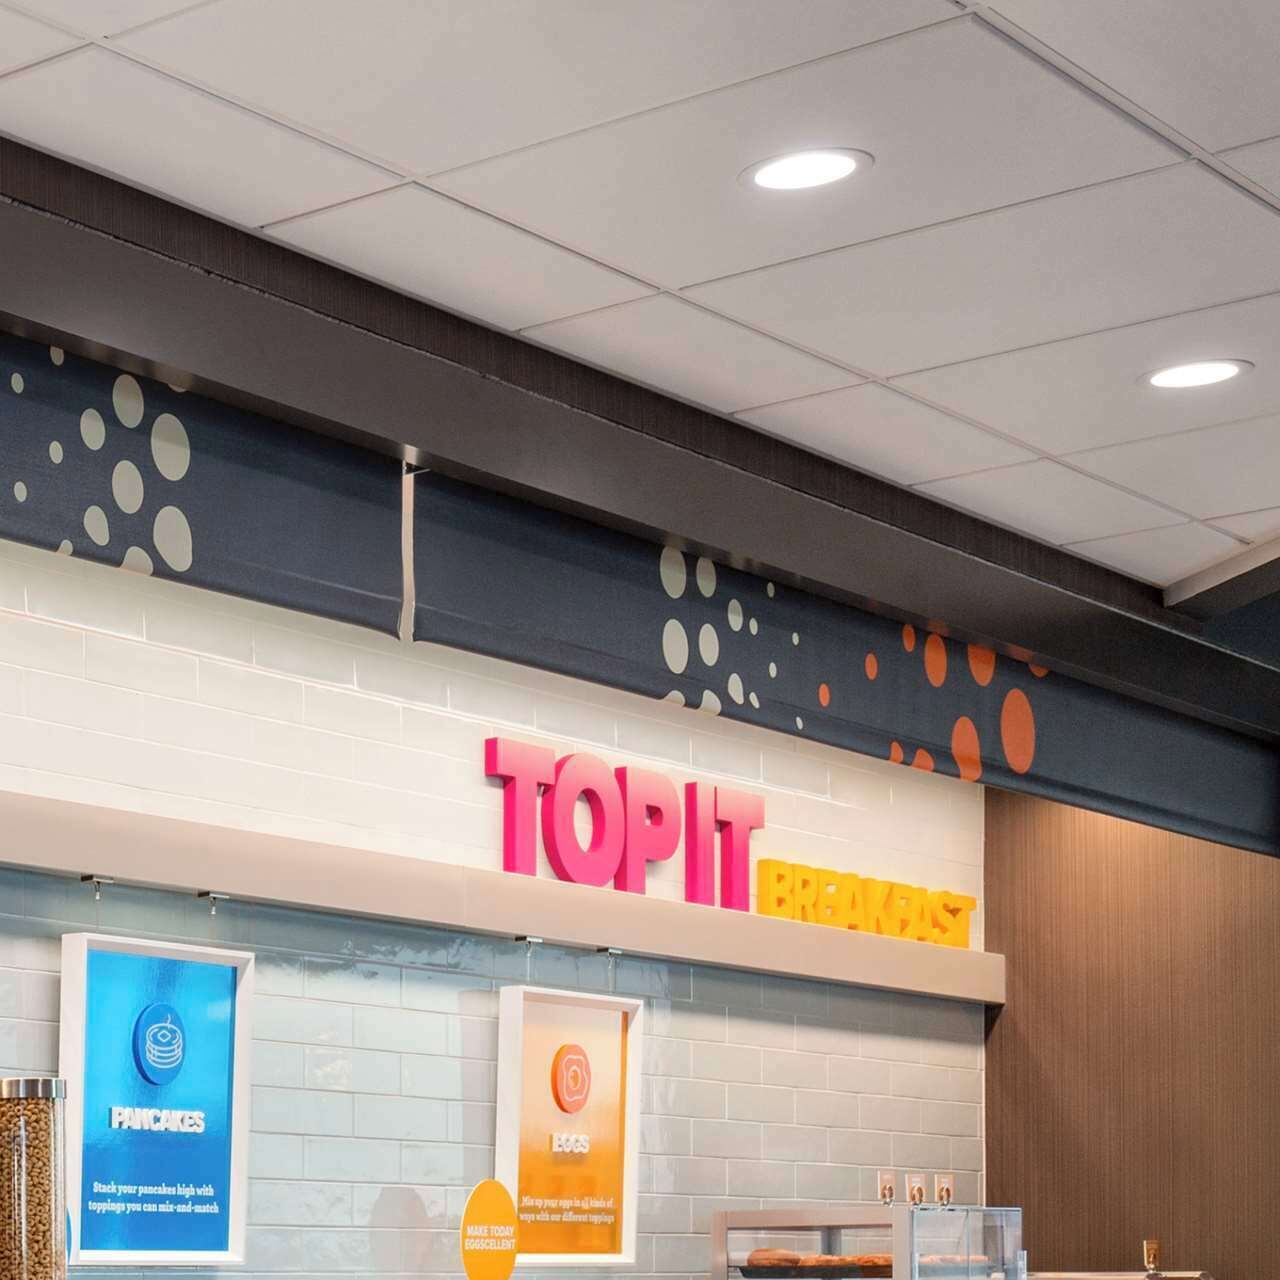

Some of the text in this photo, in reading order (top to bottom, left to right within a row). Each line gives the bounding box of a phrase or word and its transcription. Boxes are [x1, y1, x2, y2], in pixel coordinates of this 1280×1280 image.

[757, 857, 977, 949] BREAKFAST
[110, 1106, 205, 1133] PANCAKES
[93, 1181, 214, 1198] Stack your pancakes high with
[89, 1199, 125, 1214] toppings
[127, 1202, 141, 1214] you
[143, 1203, 157, 1212] can
[467, 1225, 514, 1236] MAKE TODAY
[464, 1239, 516, 1250] EGGSCELLENT
